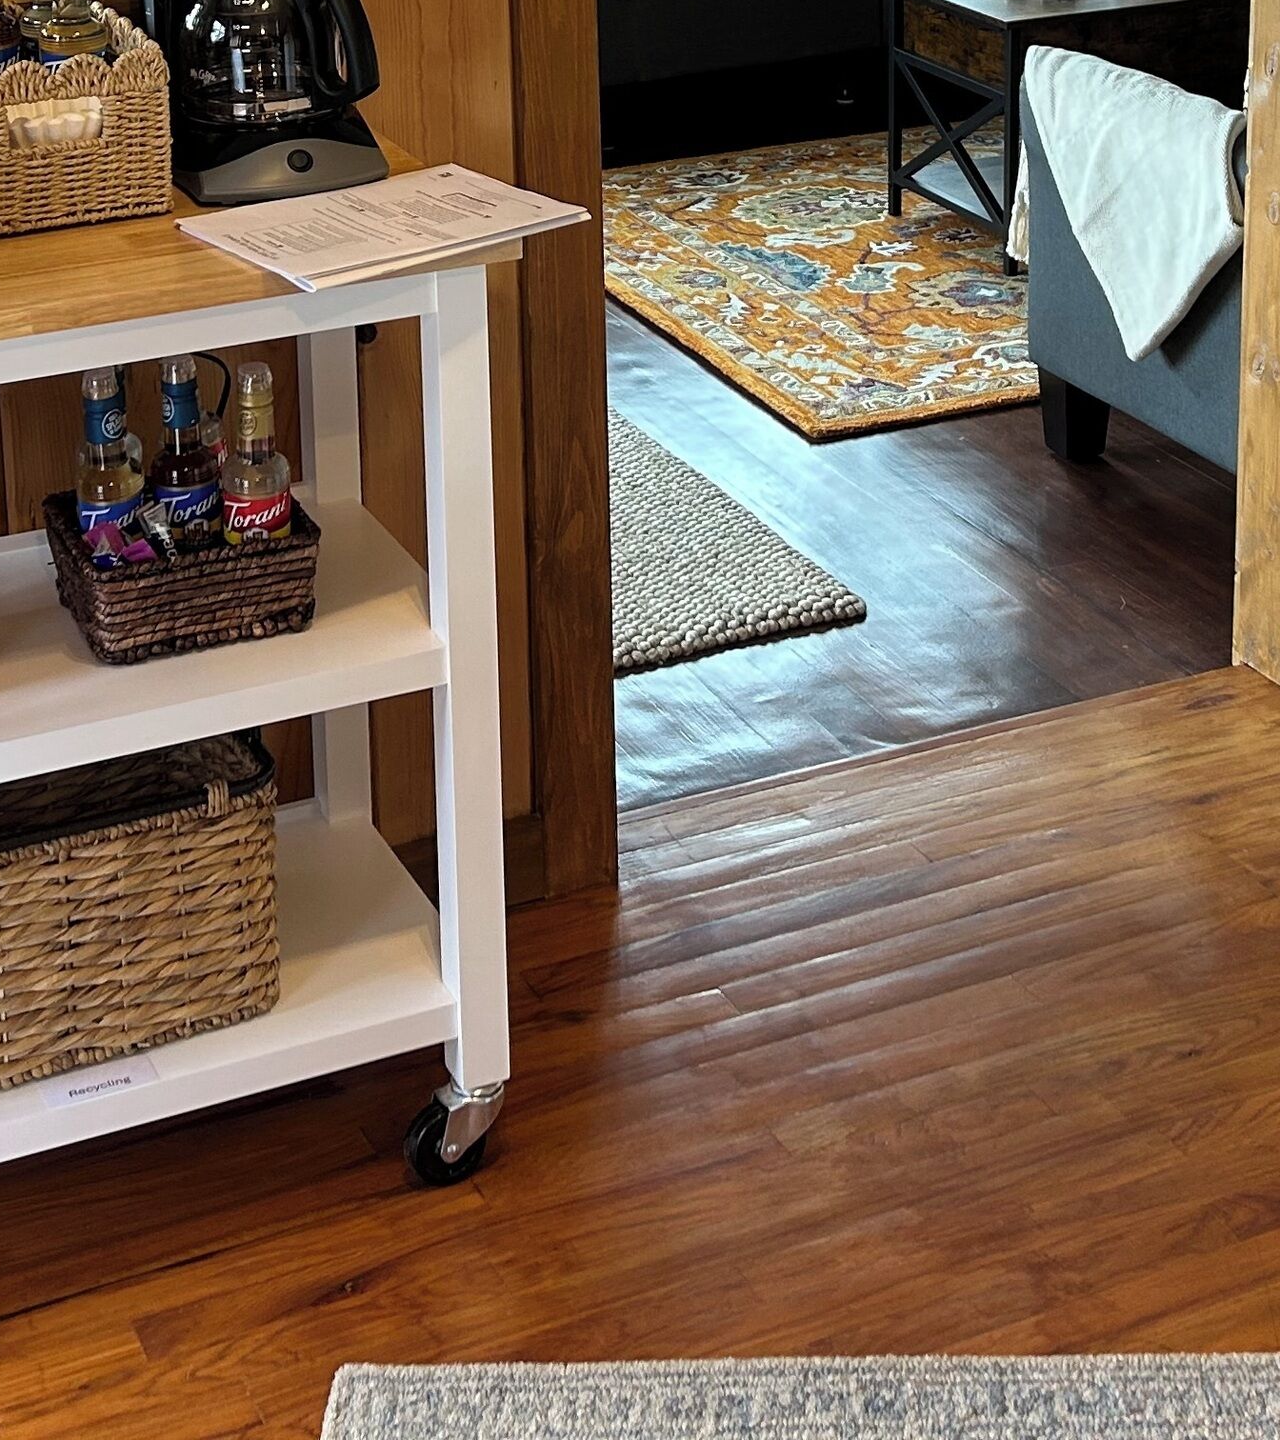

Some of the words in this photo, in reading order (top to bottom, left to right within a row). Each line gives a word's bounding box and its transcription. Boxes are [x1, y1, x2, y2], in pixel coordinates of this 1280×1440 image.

[159, 490, 219, 527] Toran
[224, 491, 288, 531] Torani
[68, 1075, 132, 1098] Recycling
